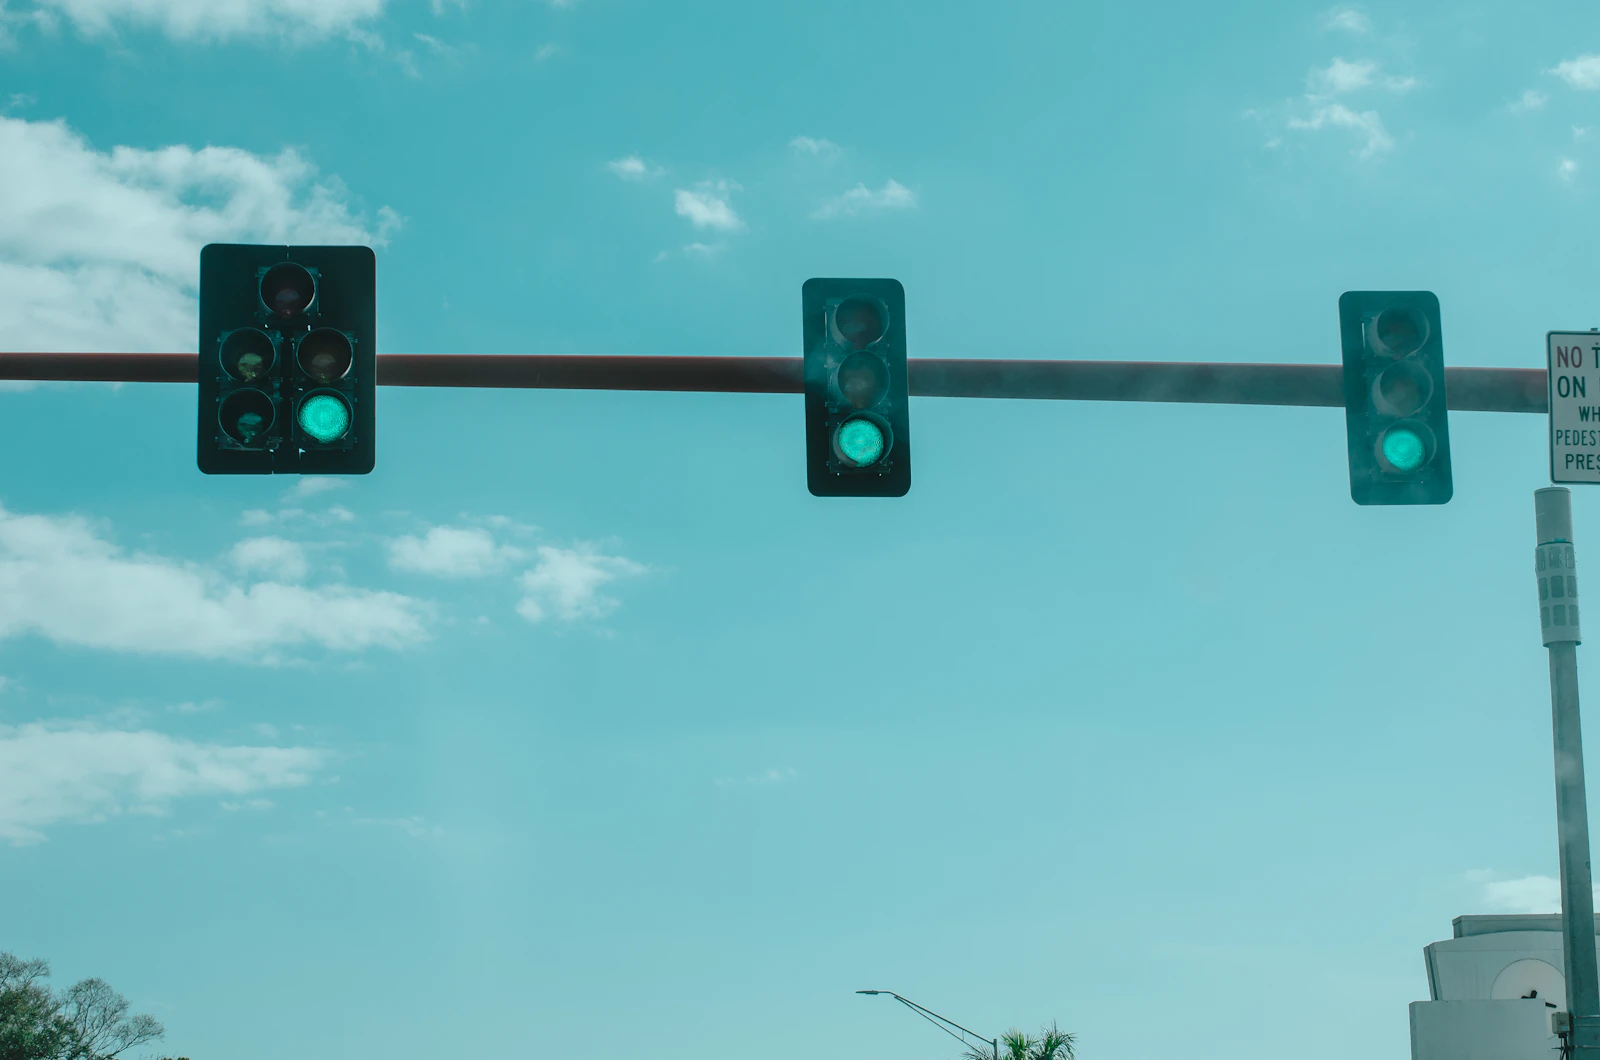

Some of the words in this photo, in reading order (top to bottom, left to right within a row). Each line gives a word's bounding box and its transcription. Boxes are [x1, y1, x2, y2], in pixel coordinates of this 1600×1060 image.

[1556, 345, 1583, 369] NO
[1557, 375, 1586, 398] ON
[1578, 405, 1600, 423] WH
[1555, 429, 1600, 447] PEDES
